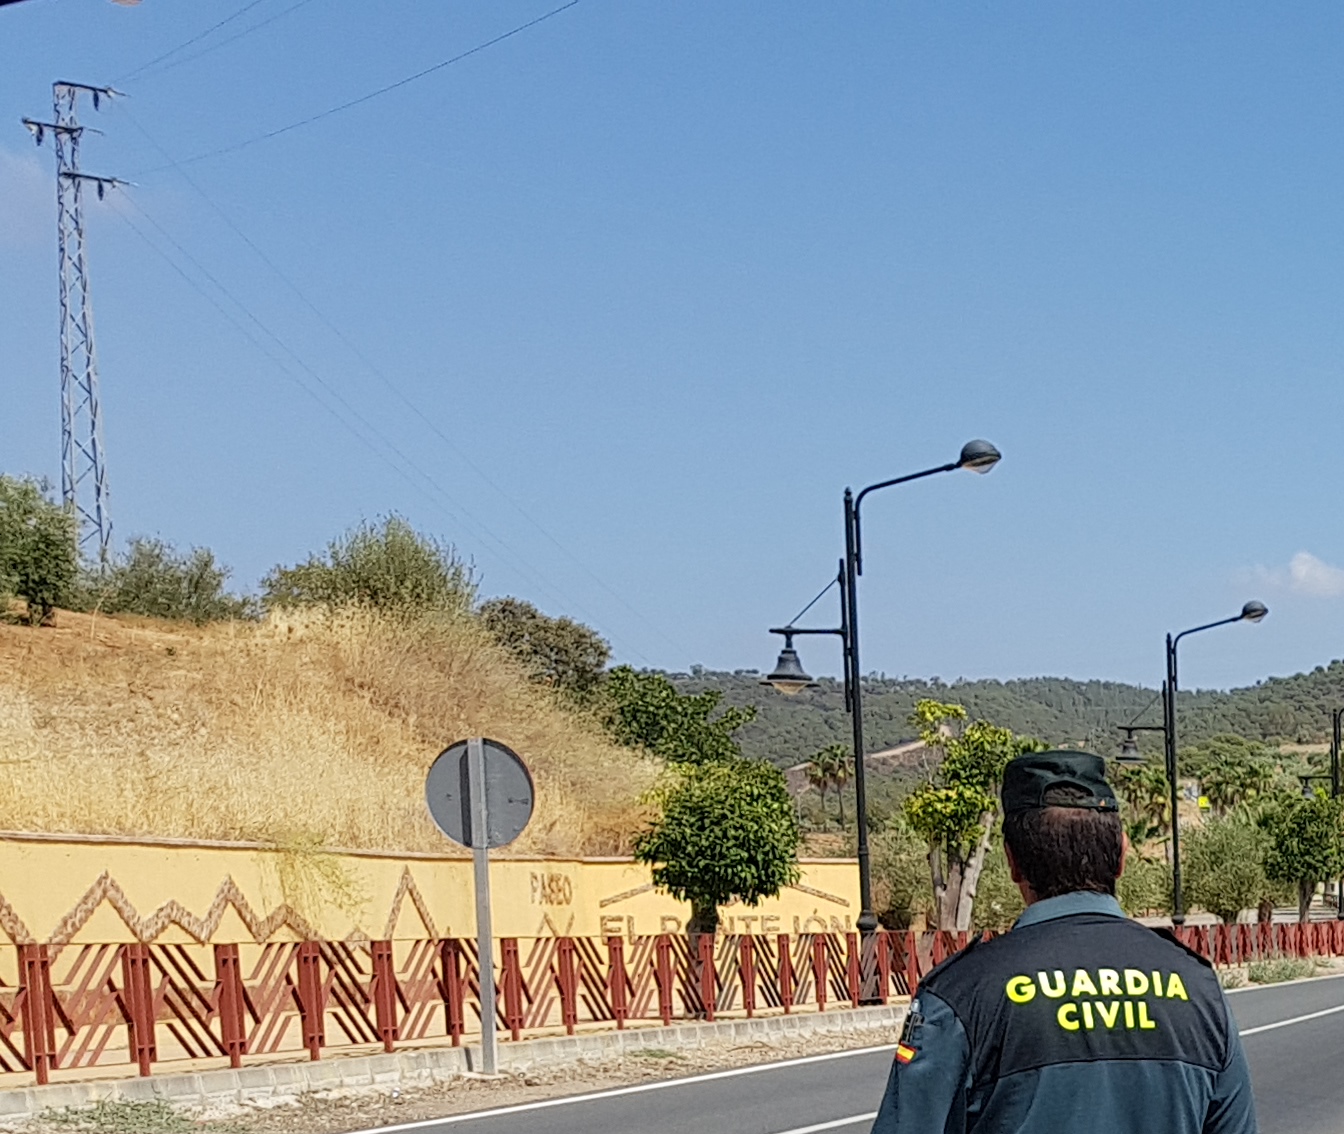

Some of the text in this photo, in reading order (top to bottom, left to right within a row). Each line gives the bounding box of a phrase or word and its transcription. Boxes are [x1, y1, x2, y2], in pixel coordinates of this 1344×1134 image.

[530, 871, 573, 906] PASEO
[1005, 969, 1189, 1003] GUARDIA
[1057, 1001, 1156, 1031] CIVIL
